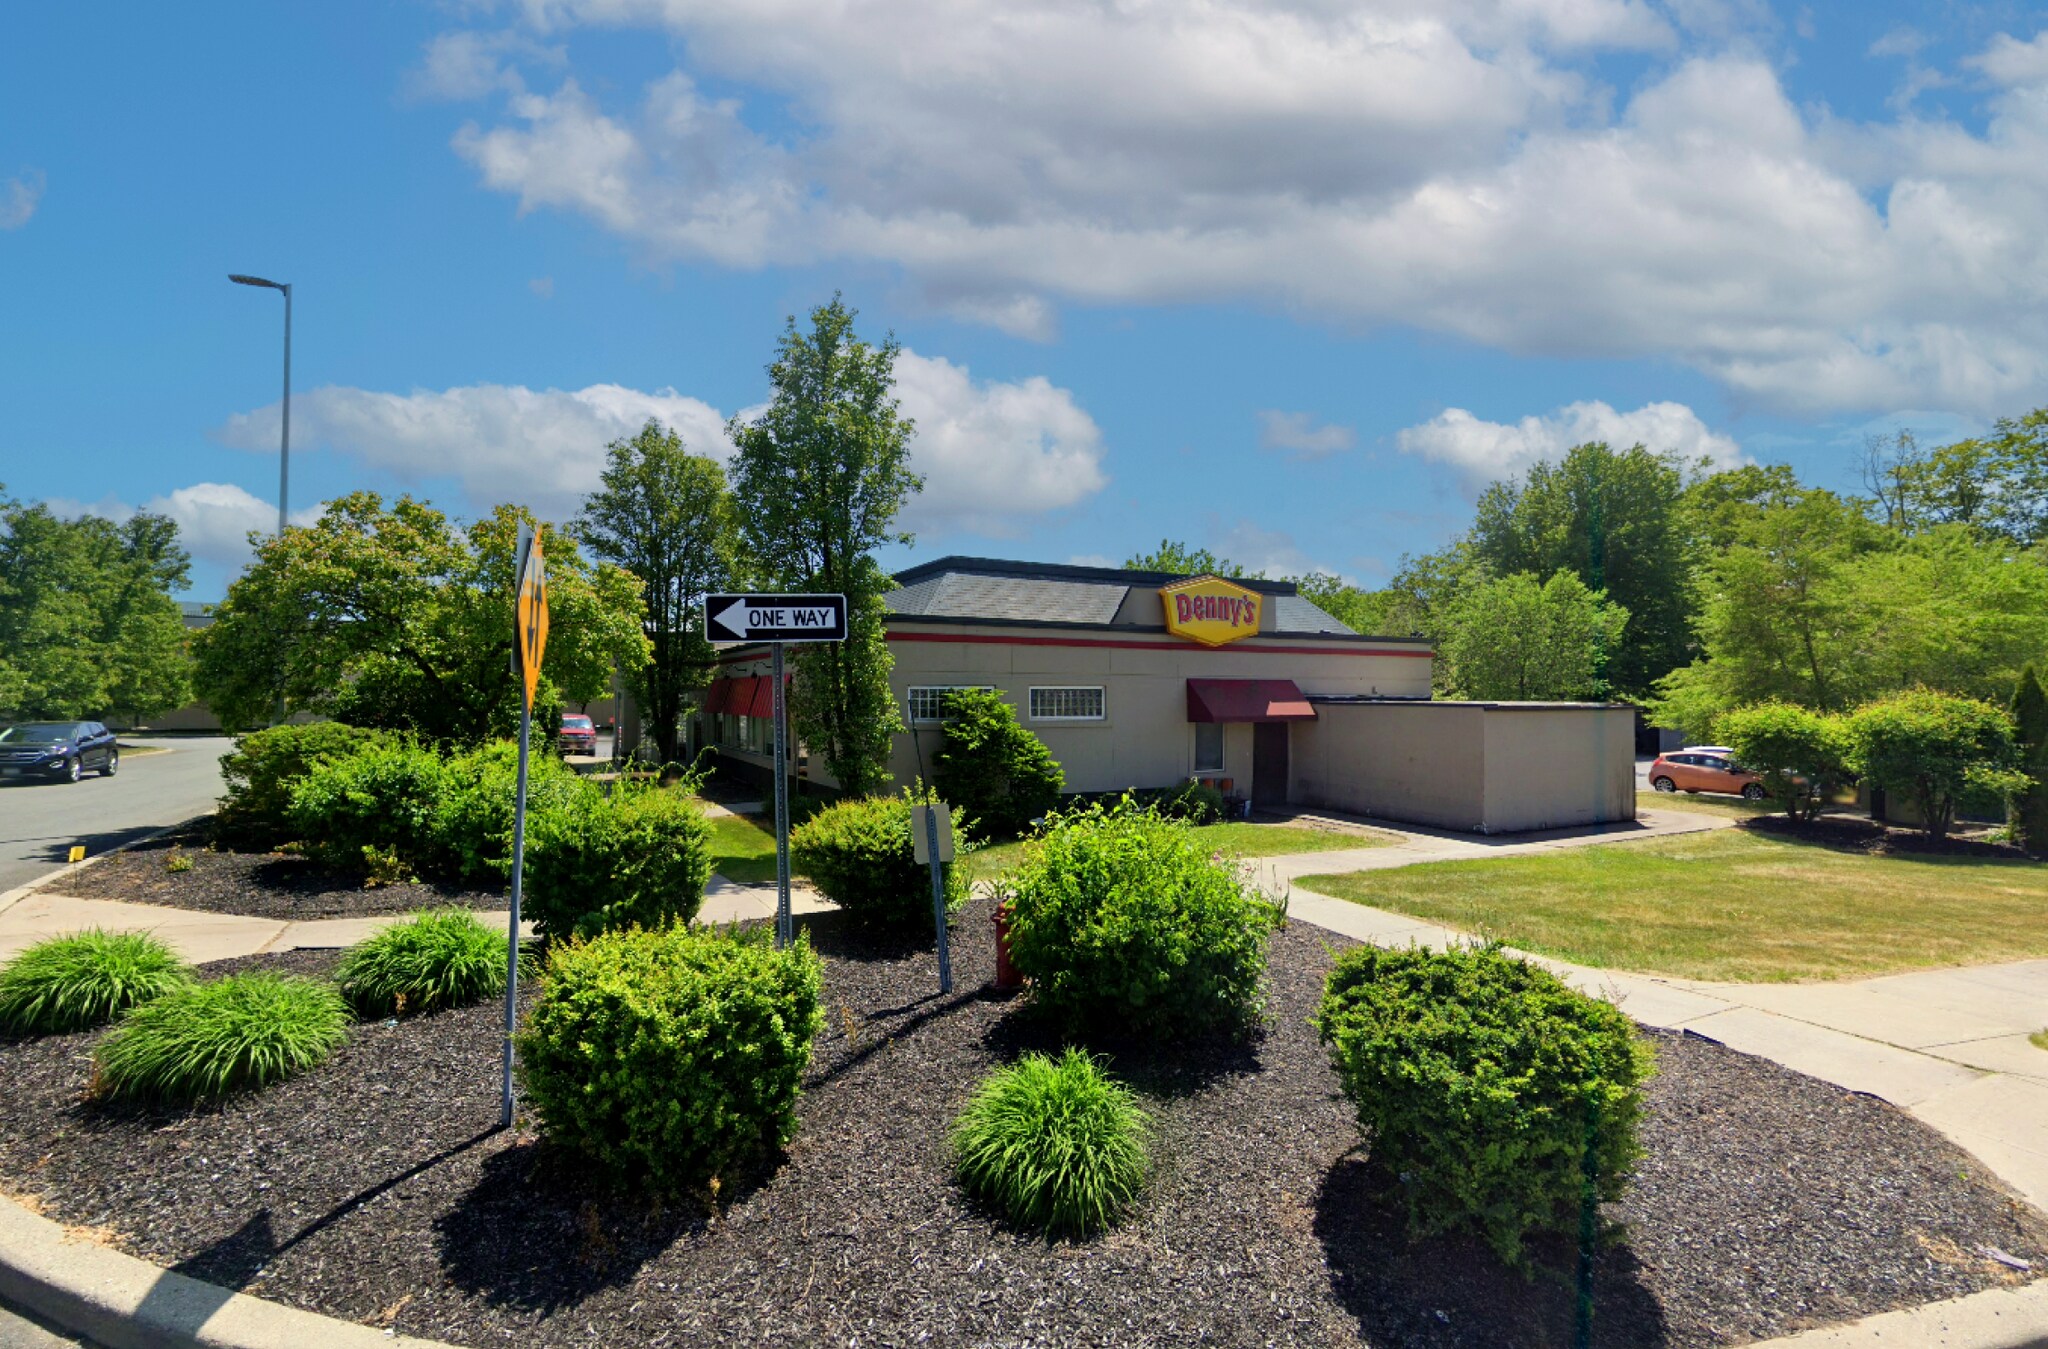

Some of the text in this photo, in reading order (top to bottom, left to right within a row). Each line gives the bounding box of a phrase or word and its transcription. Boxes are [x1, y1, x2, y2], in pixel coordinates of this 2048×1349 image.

[749, 609, 830, 627] ONE WAY
[1175, 593, 1256, 627] Denny's
